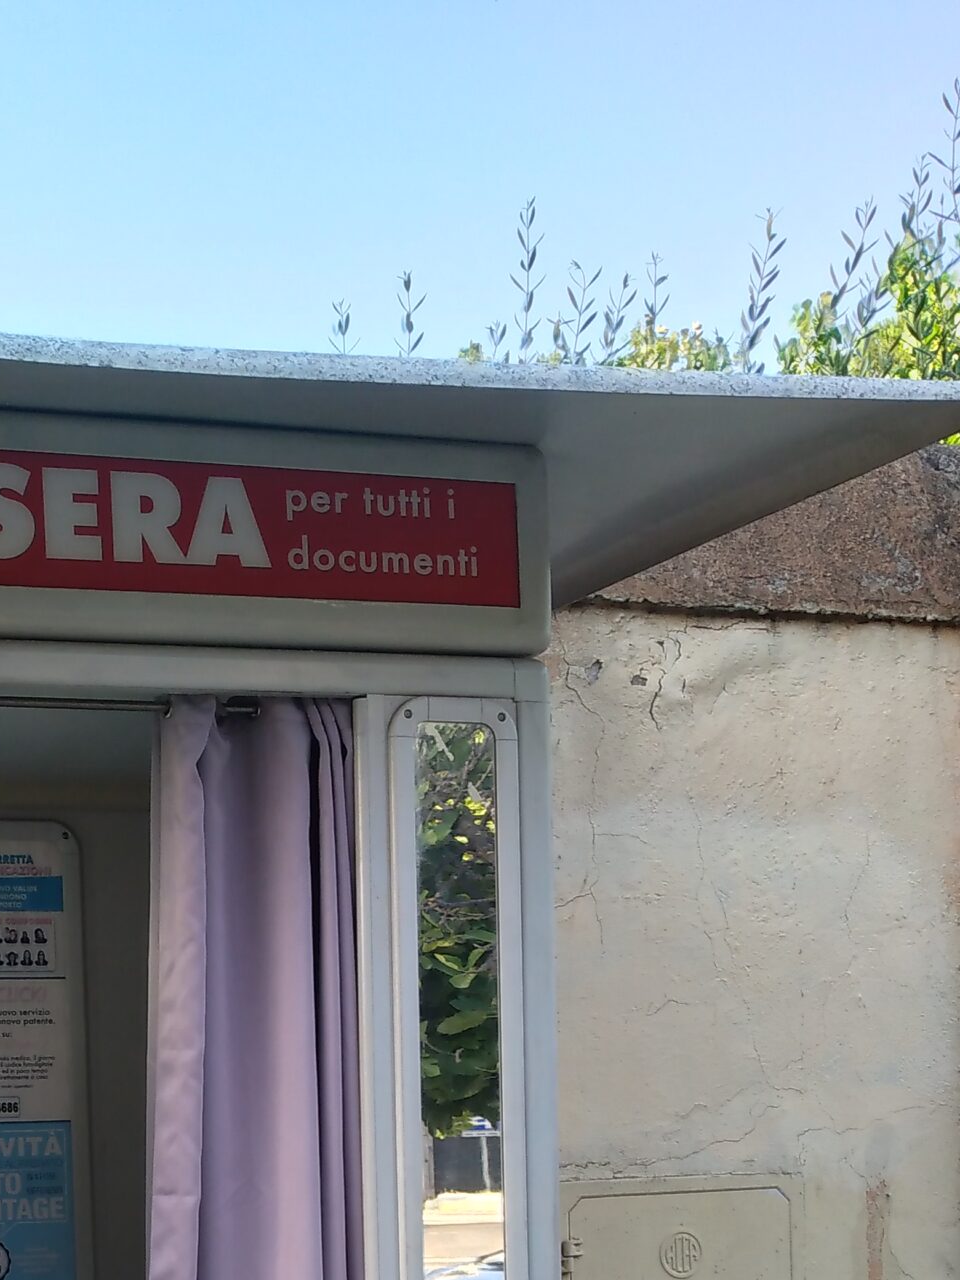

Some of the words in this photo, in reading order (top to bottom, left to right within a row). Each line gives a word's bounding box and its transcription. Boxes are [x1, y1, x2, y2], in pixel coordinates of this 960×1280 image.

[286, 487, 348, 521] per
[363, 487, 431, 518] tutti
[447, 488, 455, 519] i
[287, 534, 478, 577] documenti
[19, 1008, 50, 1016] servizio
